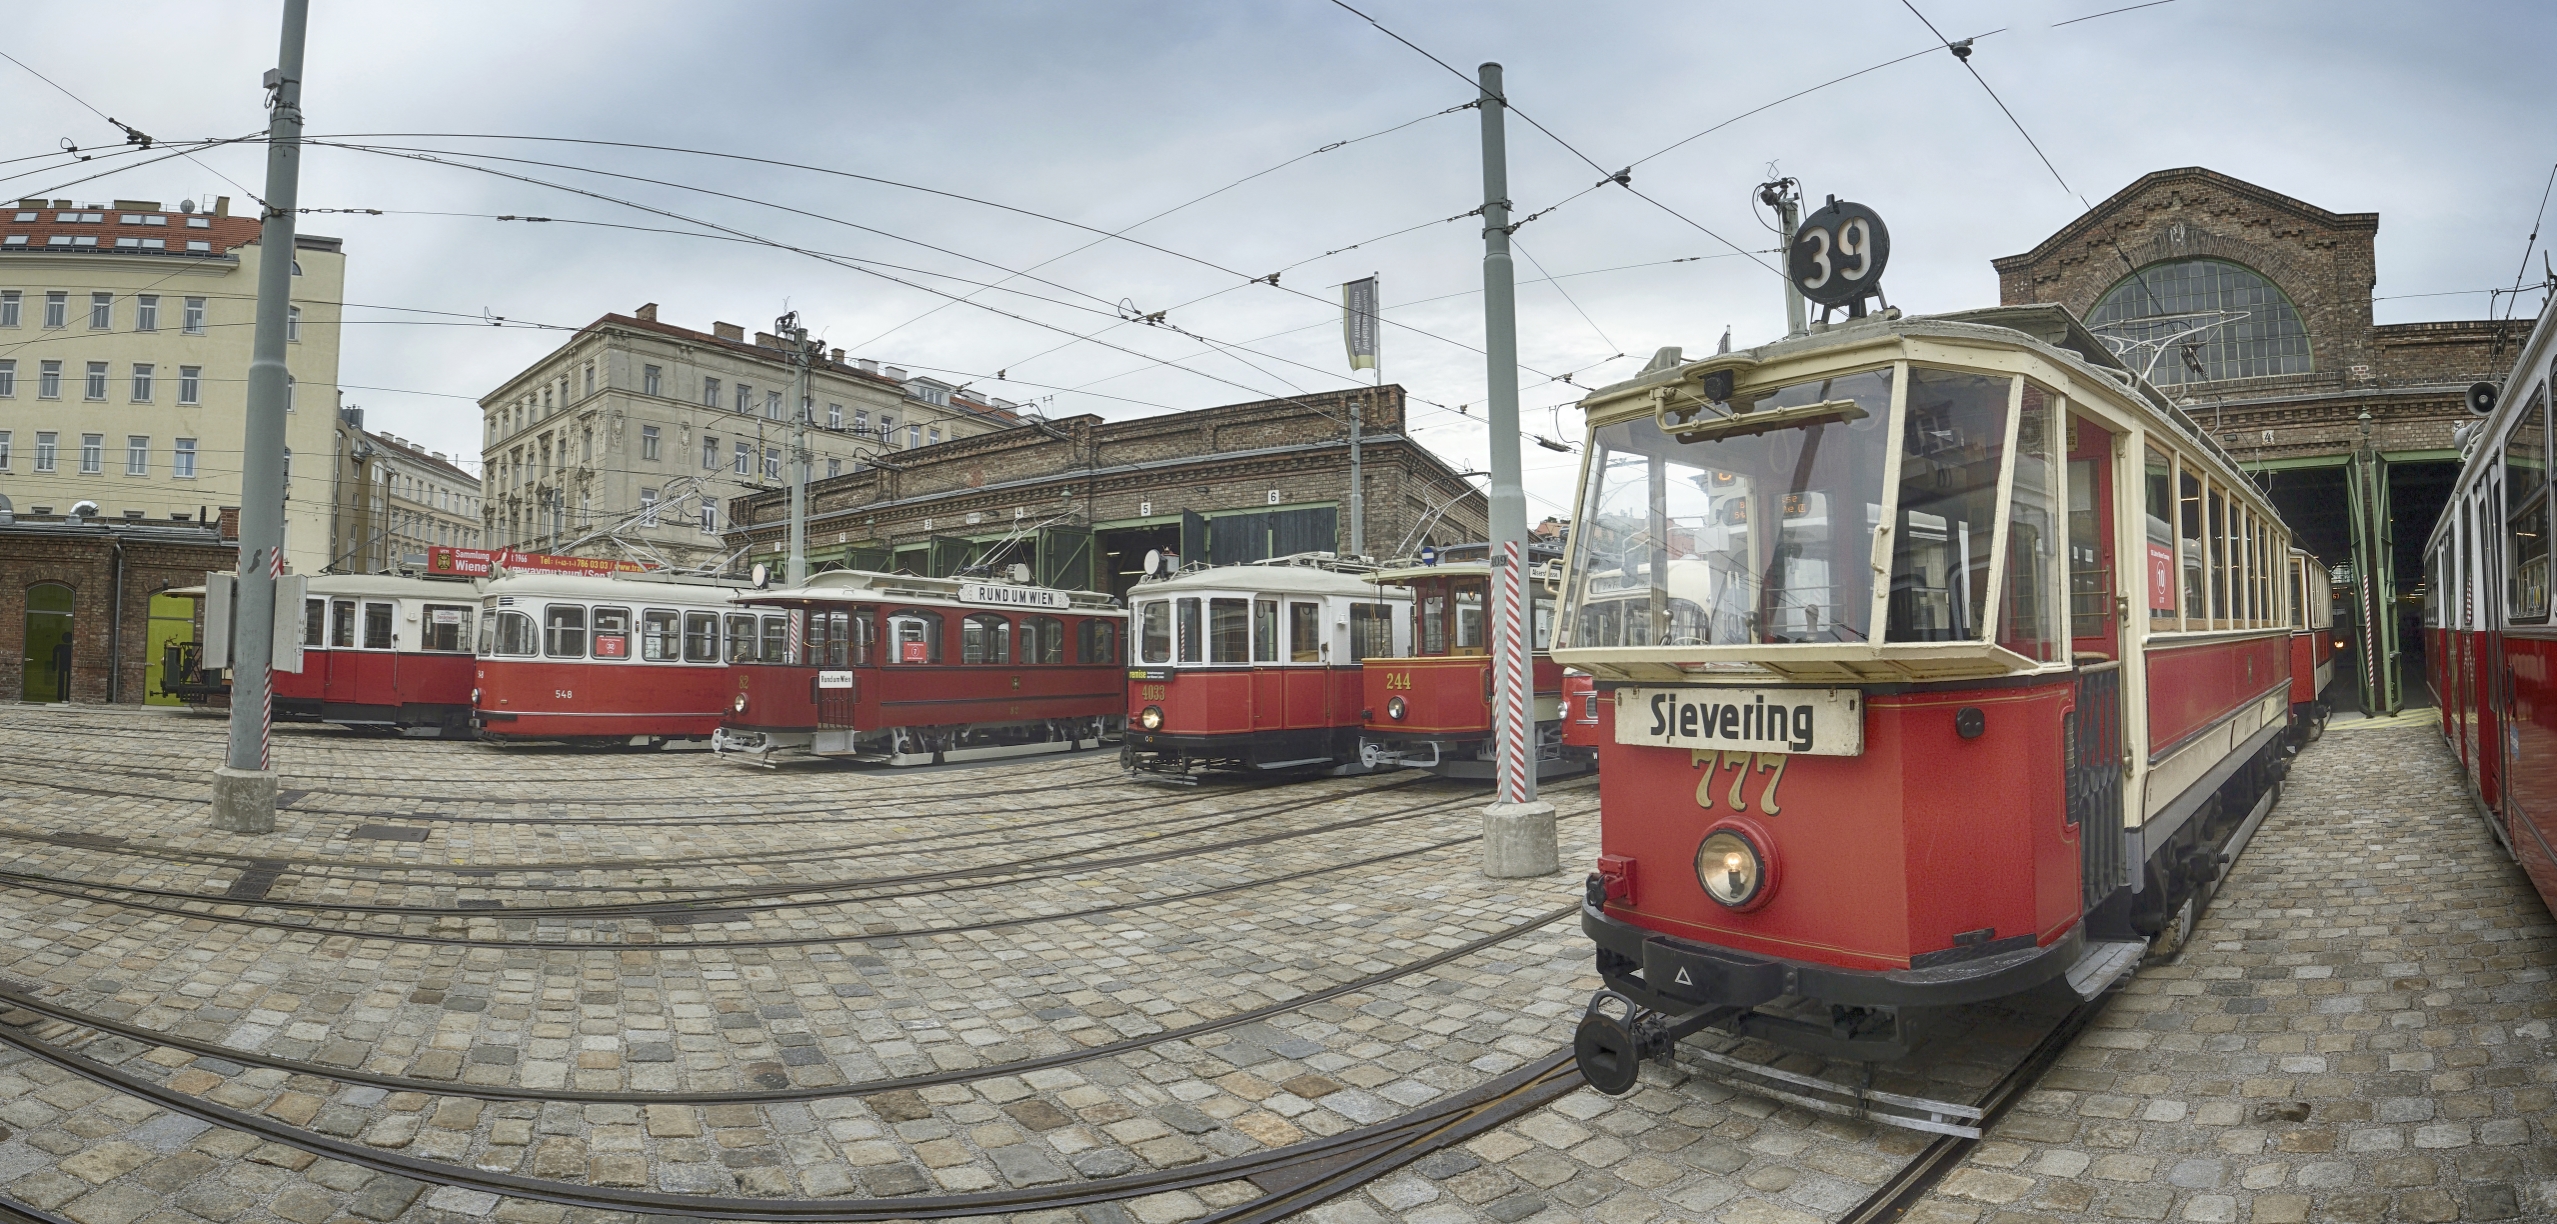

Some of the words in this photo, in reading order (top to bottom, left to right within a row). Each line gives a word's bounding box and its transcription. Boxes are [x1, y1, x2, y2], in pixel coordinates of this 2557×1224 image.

[1801, 216, 1872, 289] 39
[1270, 492, 1277, 502] 6
[1143, 505, 1149, 514] 5
[455, 549, 490, 561] Sammlung
[455, 559, 489, 572] Wiene
[590, 560, 599, 569] 03
[600, 561, 609, 570] 03
[2158, 568, 2165, 588] 10
[979, 586, 1009, 602] RUND
[1011, 590, 1026, 604] UM
[1028, 591, 1054, 605] WIEN
[1129, 669, 1147, 679] remise
[1386, 672, 1411, 690] 244
[739, 675, 749, 689] 82
[555, 689, 573, 699] 548
[1141, 684, 1166, 701] 4033
[1650, 693, 1814, 752] Sievering
[1691, 749, 1790, 816] 777
